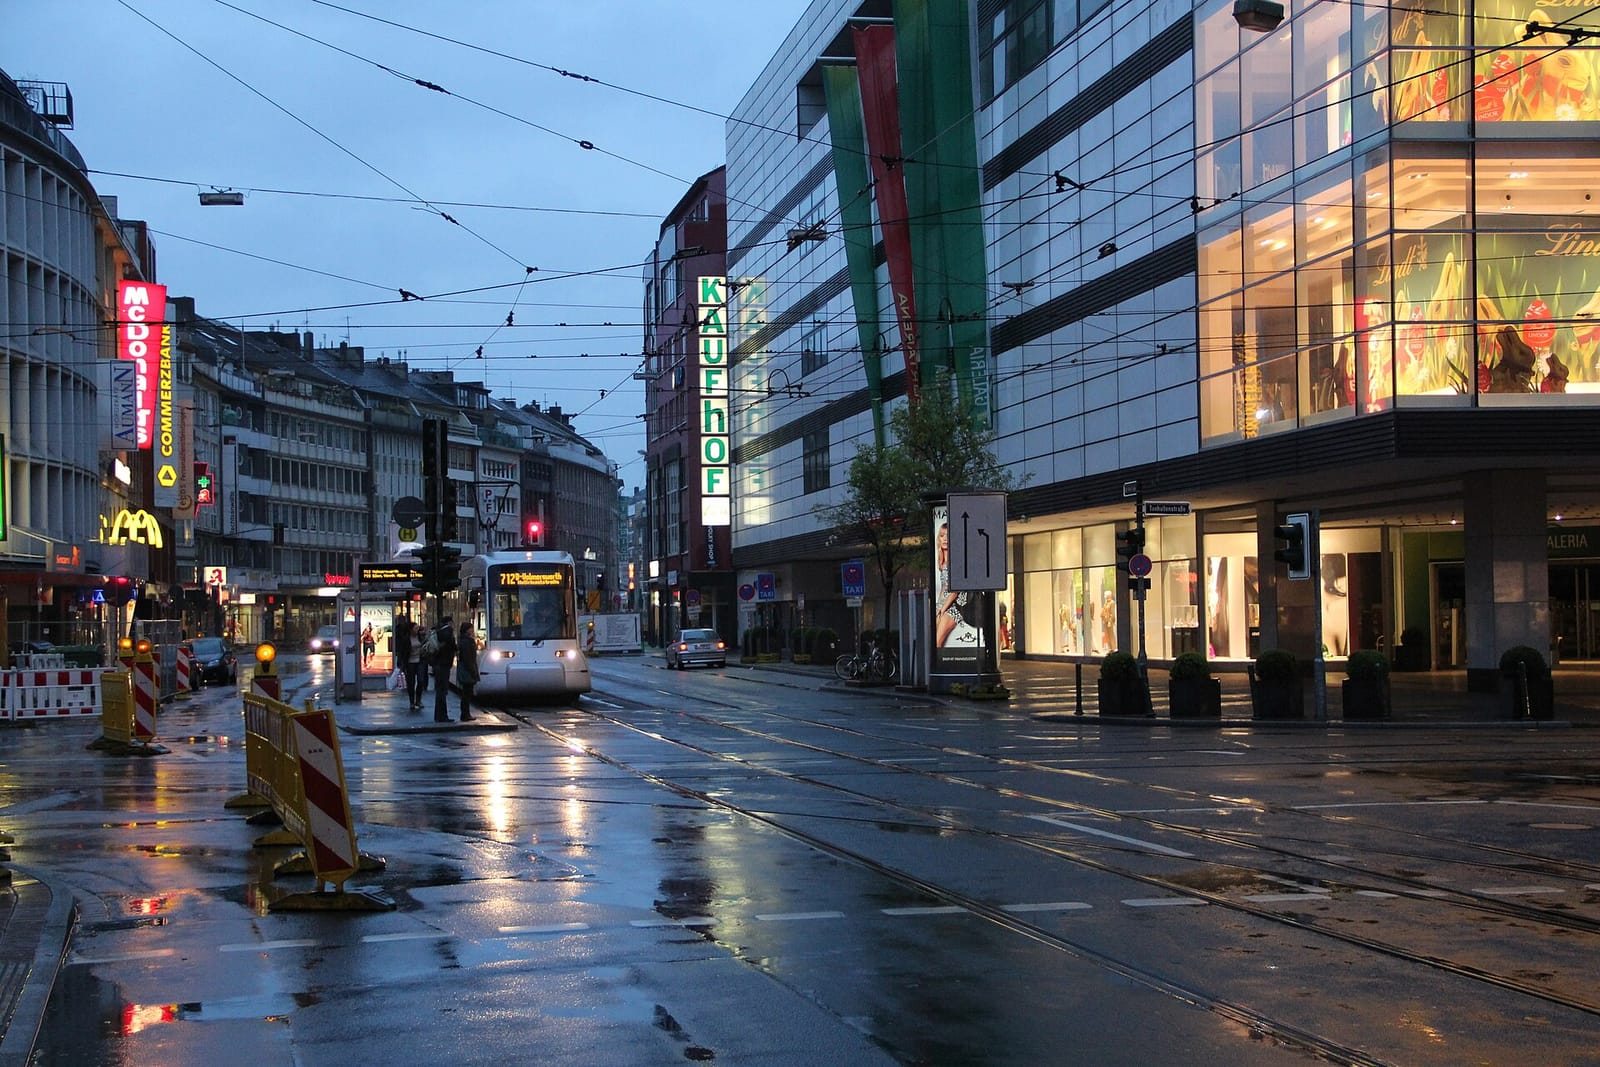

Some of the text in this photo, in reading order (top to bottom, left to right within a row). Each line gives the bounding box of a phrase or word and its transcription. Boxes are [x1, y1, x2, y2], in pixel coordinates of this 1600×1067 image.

[160, 324, 173, 457] COMMERZBANK
[114, 366, 135, 444] AUMANN
[1547, 534, 1588, 549] ALERIA
[500, 573, 516, 585] 712
[845, 586, 863, 594] TAXI
